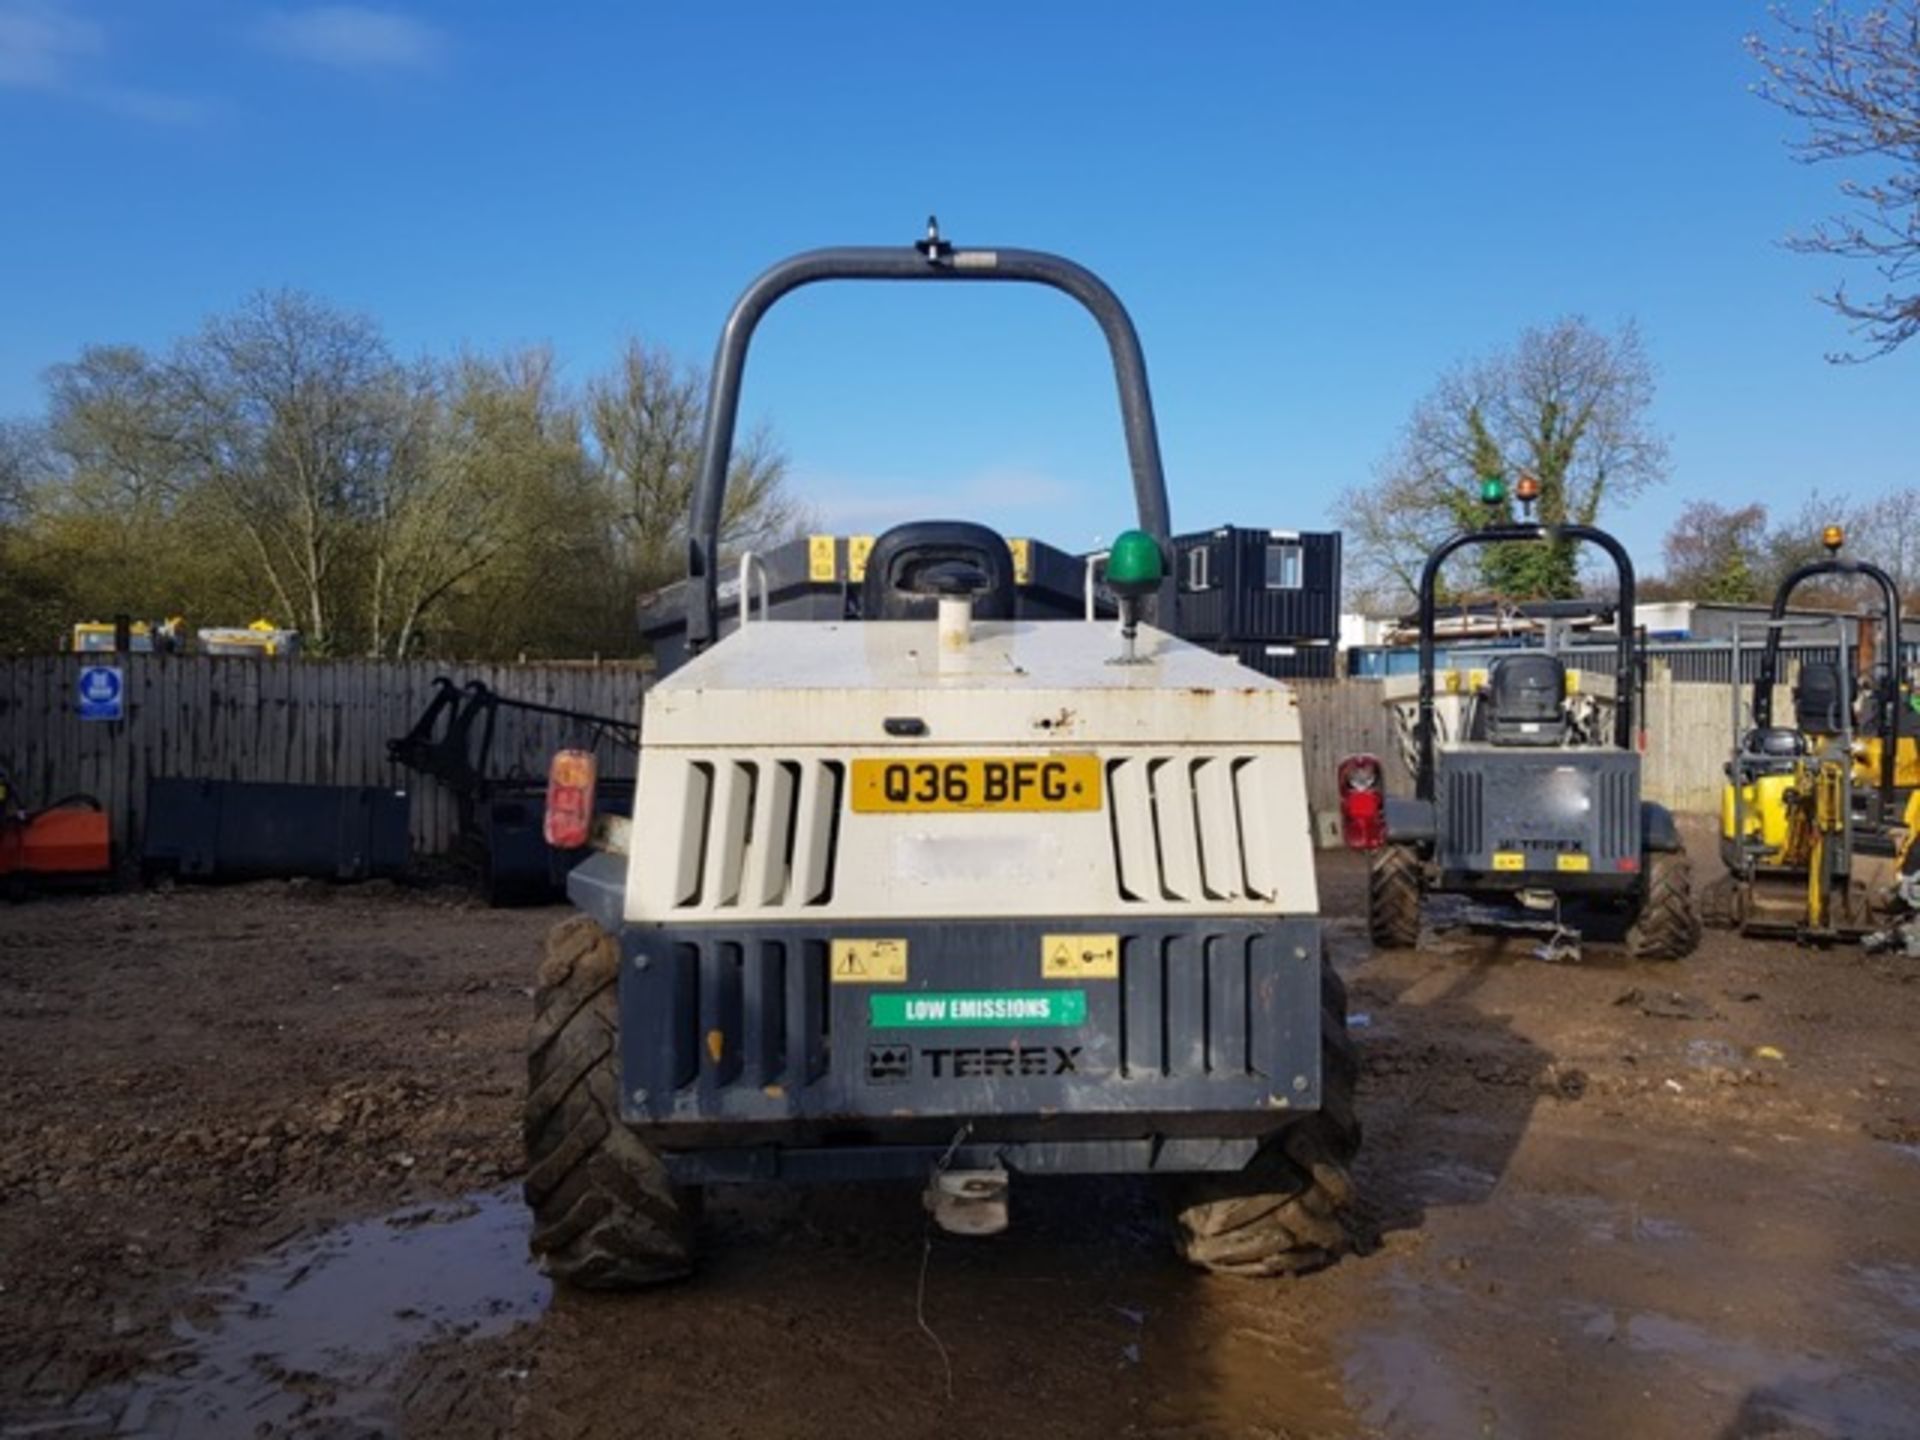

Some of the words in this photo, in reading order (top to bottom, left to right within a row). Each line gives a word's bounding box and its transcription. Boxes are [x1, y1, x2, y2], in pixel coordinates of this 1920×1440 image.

[884, 763, 969, 802] Q36
[983, 762, 1067, 802] BFG
[905, 1000, 946, 1020] LOW
[951, 998, 1051, 1019] EMISSIONS
[921, 1047, 1083, 1078] TEREX
